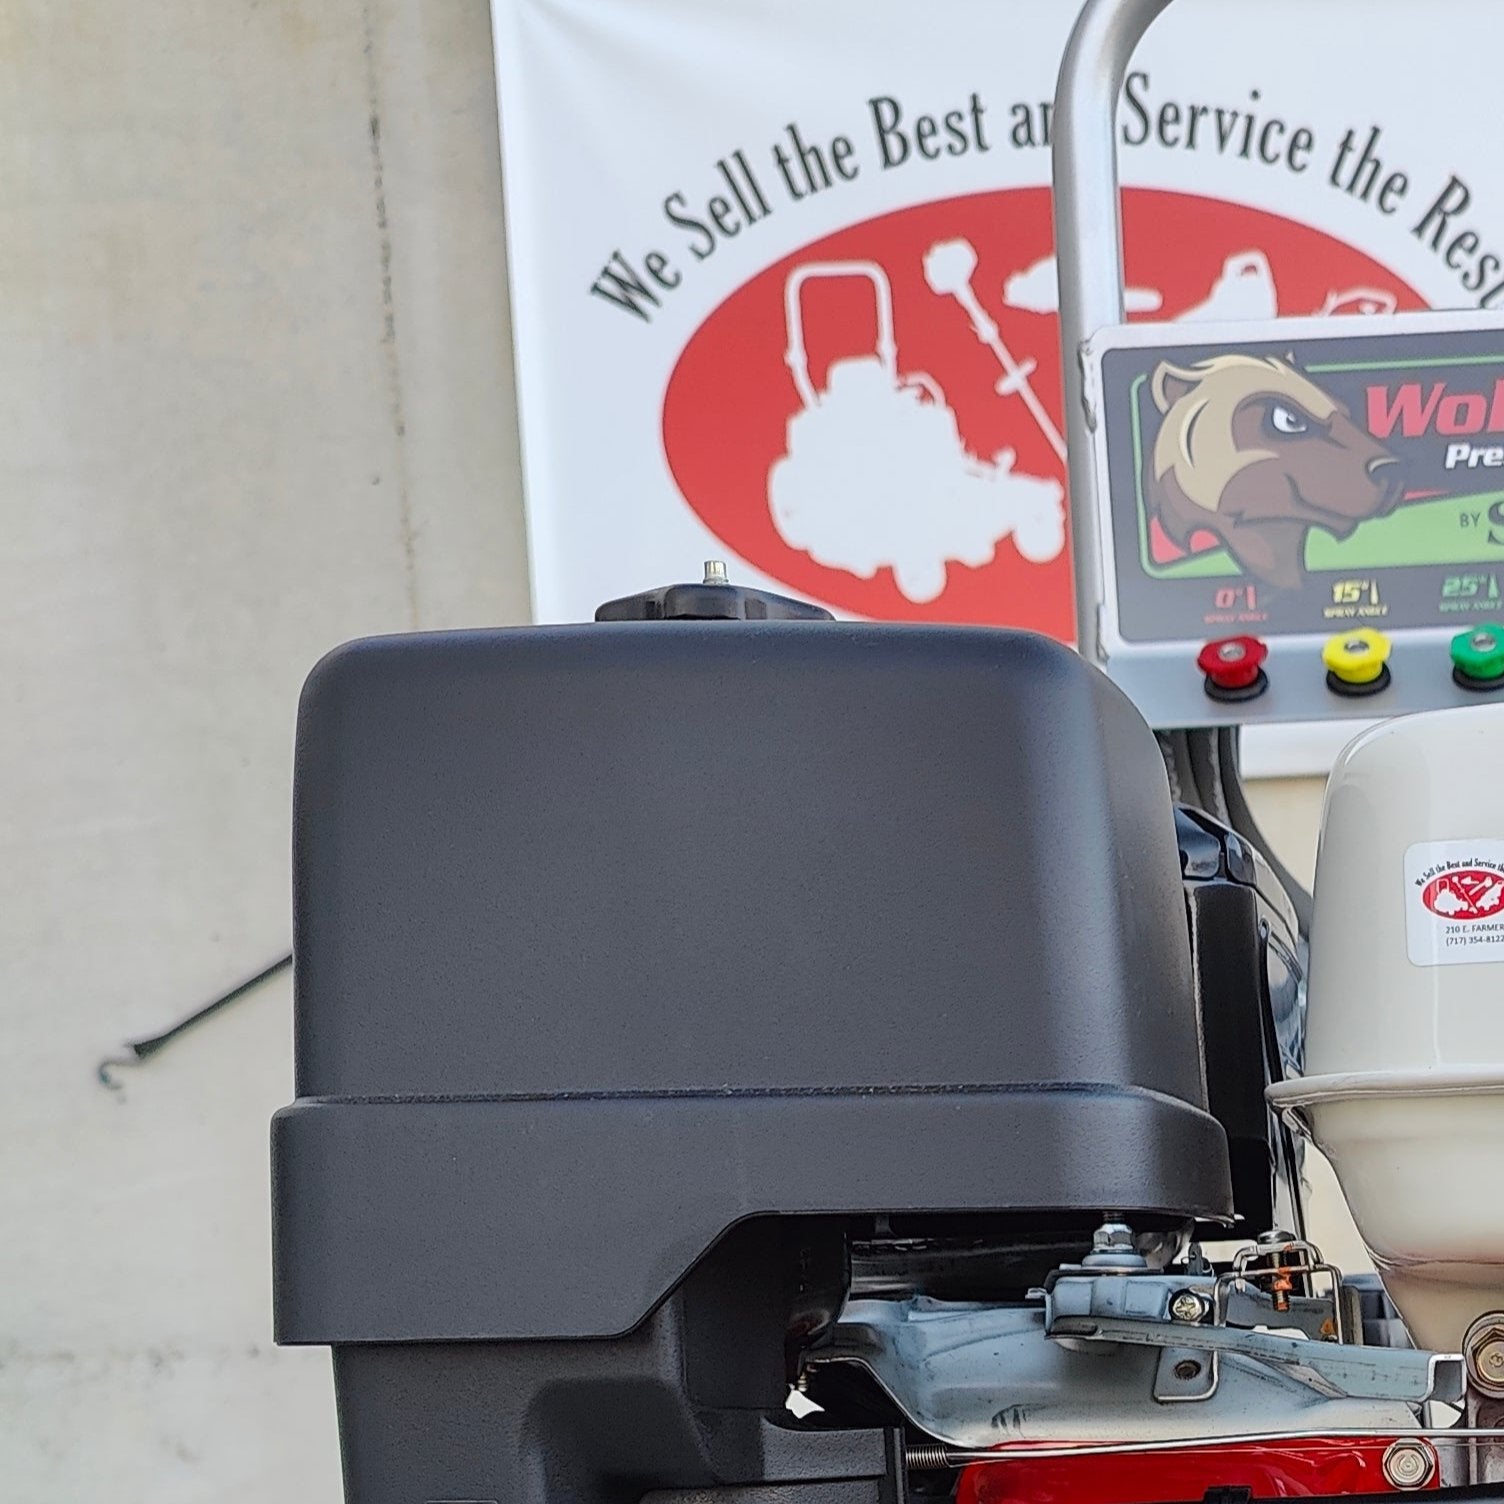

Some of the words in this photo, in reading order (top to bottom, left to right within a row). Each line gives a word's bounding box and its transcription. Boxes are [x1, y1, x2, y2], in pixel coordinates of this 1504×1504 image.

[589, 248, 683, 324] We
[663, 148, 773, 262] Sell
[771, 121, 860, 201] the
[868, 92, 991, 170] Best
[1121, 71, 1315, 173] Service
[1329, 125, 1409, 215] the
[1459, 512, 1481, 529] BY
[1474, 858, 1497, 869] Service
[1446, 936, 1467, 947] (717)
[1468, 935, 1504, 944] 354-8122
